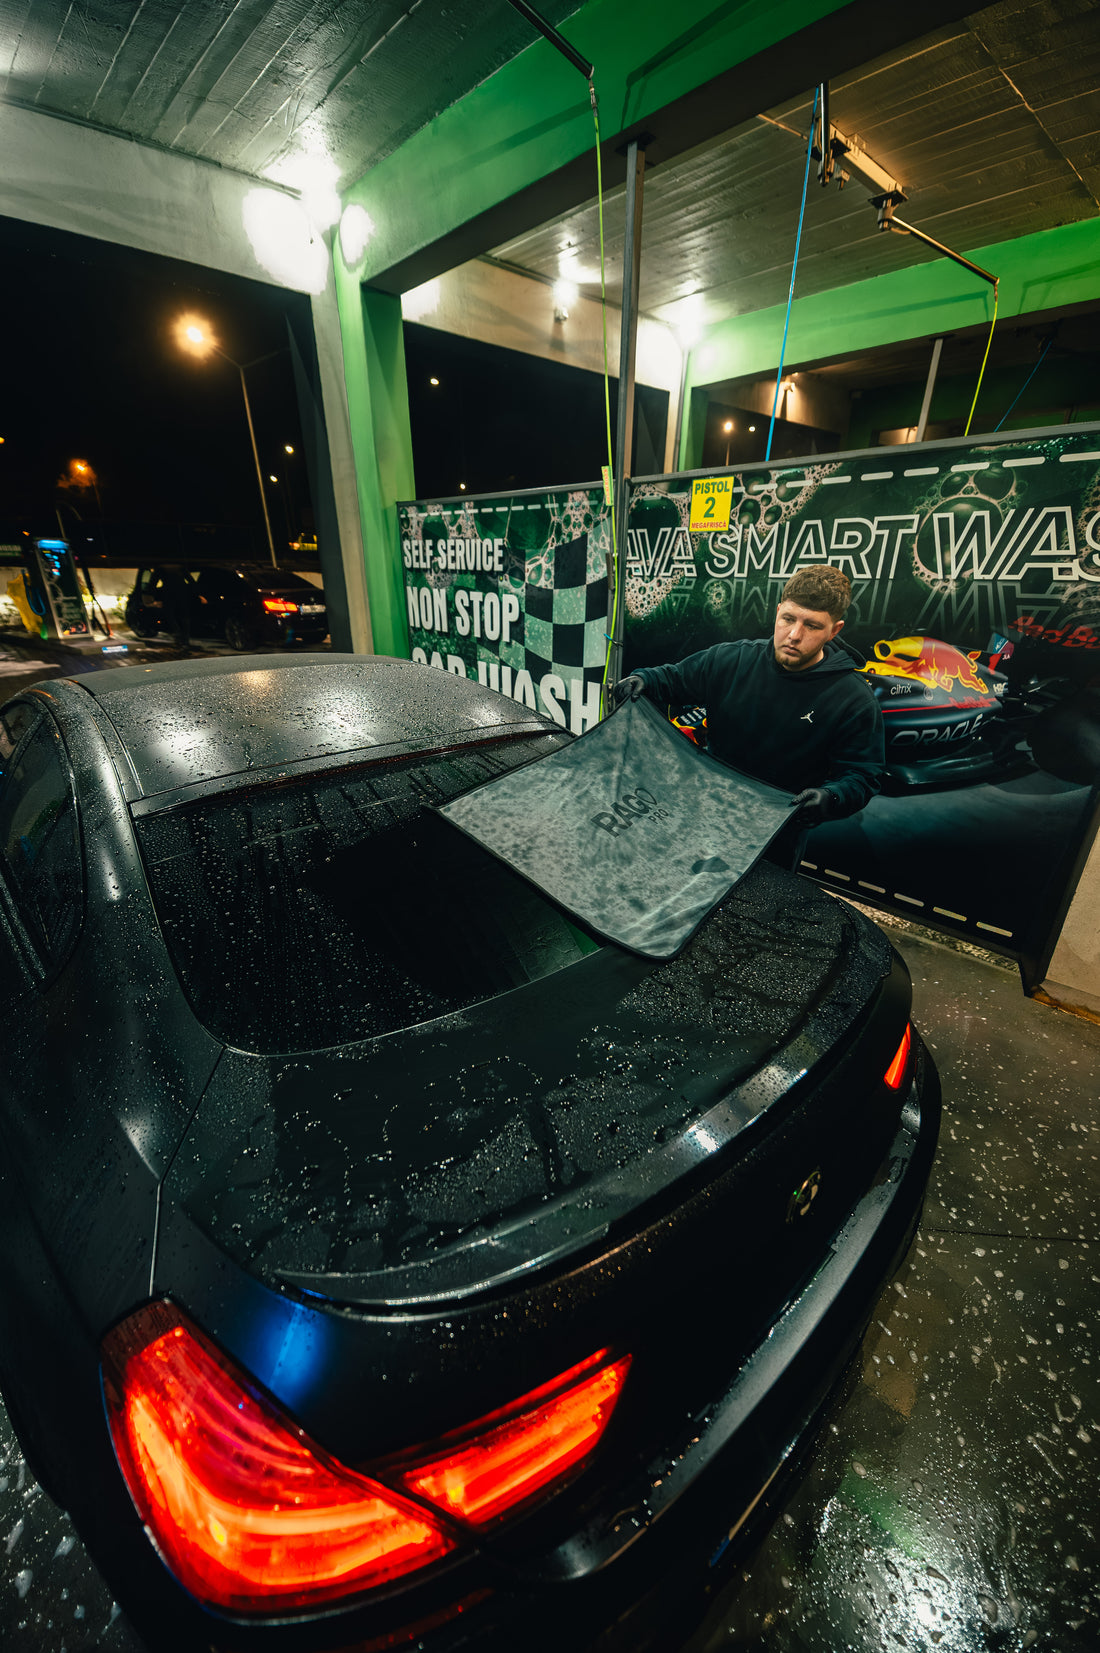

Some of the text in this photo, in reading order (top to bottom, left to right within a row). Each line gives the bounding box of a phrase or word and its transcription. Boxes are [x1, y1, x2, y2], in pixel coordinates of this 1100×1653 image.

[695, 481, 730, 495] PISTOL
[703, 496, 716, 518] 2
[403, 537, 504, 572] SELF SERVICE
[706, 516, 917, 578] SMART
[406, 586, 520, 643] NON STOP
[891, 714, 982, 744] ORACLE
[647, 808, 669, 824] PRO
